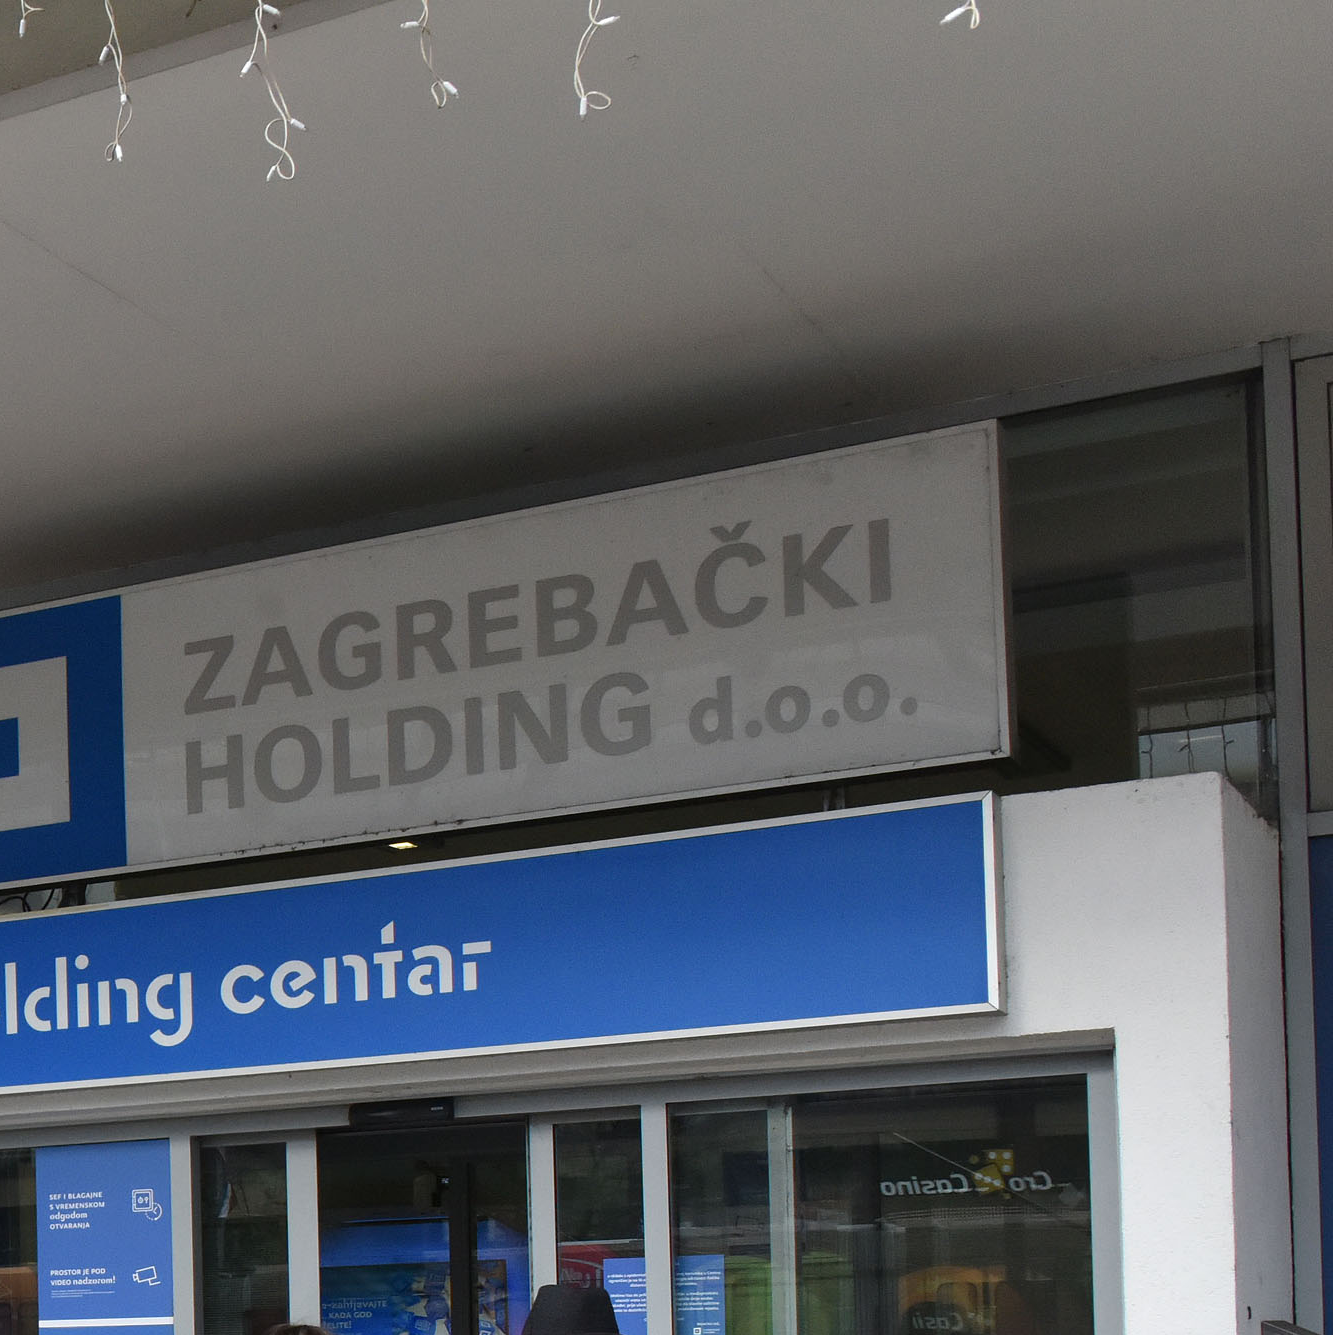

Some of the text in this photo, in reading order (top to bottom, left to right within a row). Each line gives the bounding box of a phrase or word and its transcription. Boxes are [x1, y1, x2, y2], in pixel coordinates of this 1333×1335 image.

[184, 517, 892, 717] ZAGREBAČKI
[185, 671, 920, 816] HOLDING d.o.o.
[221, 921, 492, 1014] centar
[67, 1192, 103, 1200] BLAGAJNE
[55, 1202, 105, 1210] VREMENSKOM
[49, 1212, 87, 1222] odgodom
[50, 1222, 90, 1230] OTVARANJA
[72, 1276, 116, 1285] nadzorom!
